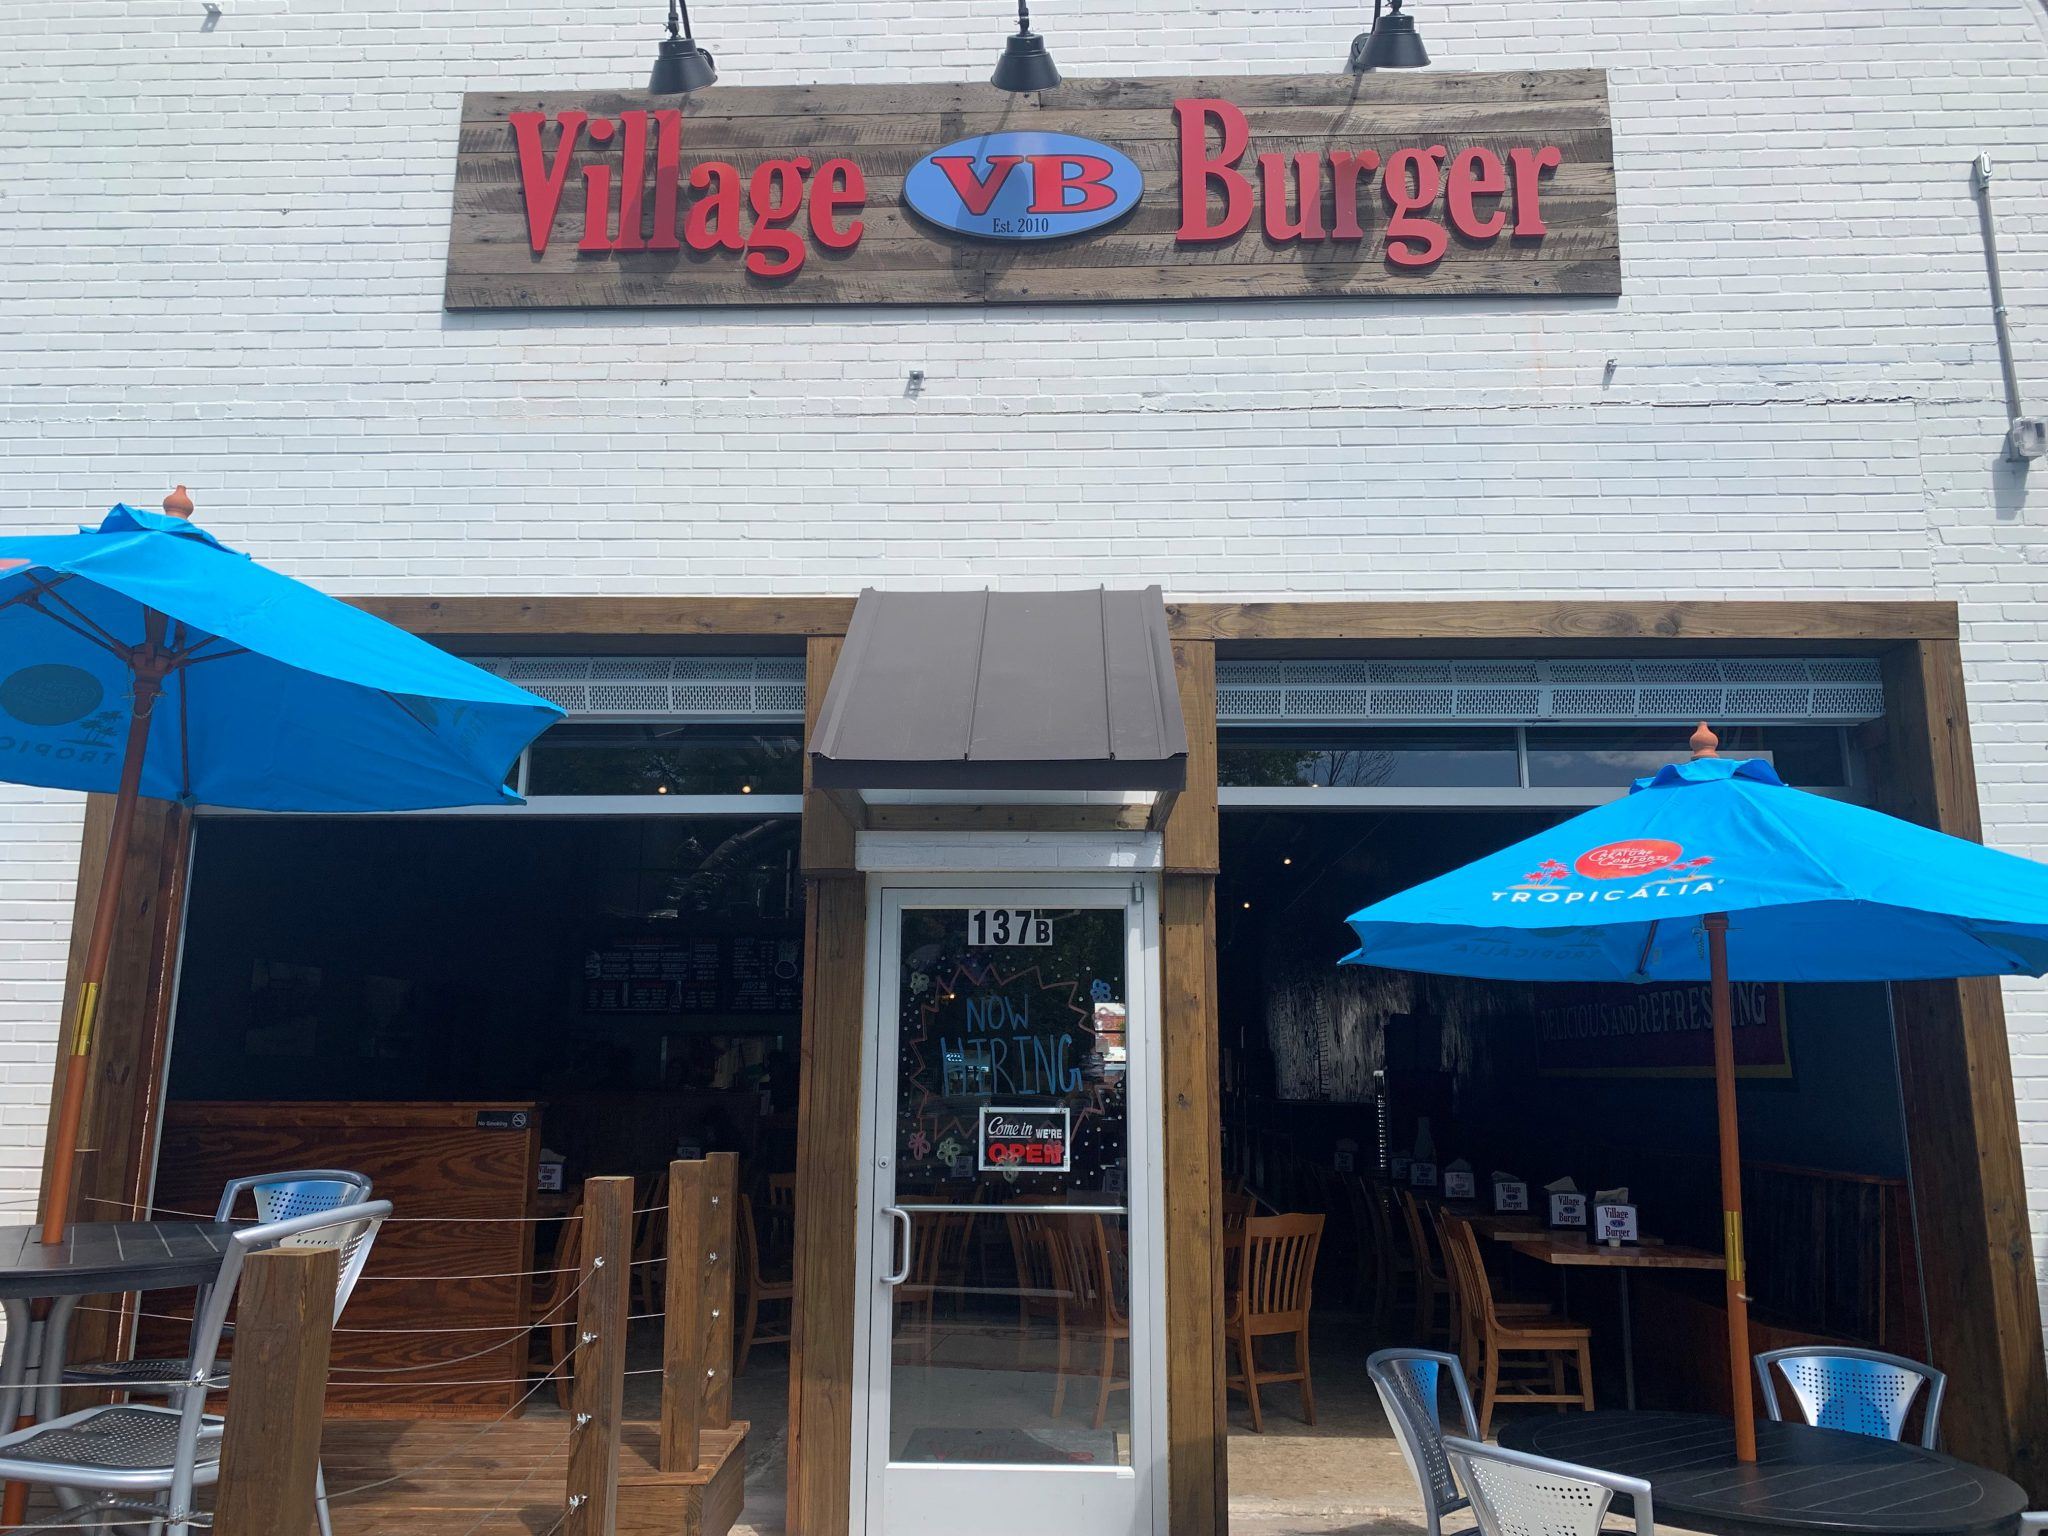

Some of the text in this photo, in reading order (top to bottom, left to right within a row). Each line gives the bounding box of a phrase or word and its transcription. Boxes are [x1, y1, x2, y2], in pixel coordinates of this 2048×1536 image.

[508, 109, 866, 278] Village
[931, 153, 1118, 216] VB
[1173, 99, 1561, 266] Burger
[992, 217, 1048, 233] Est. 2010
[966, 994, 1029, 1033] NOW
[1637, 981, 1768, 1034] REFRESING
[940, 1033, 1083, 1098] HIRING
[987, 1116, 1063, 1139] Come in WE'RE
[988, 1141, 1062, 1164] OPEN
[1558, 1195, 1580, 1209] Village
[1604, 1206, 1629, 1220] Village
[1558, 1211, 1581, 1224] Burger
[1604, 1225, 1631, 1239] Burger
